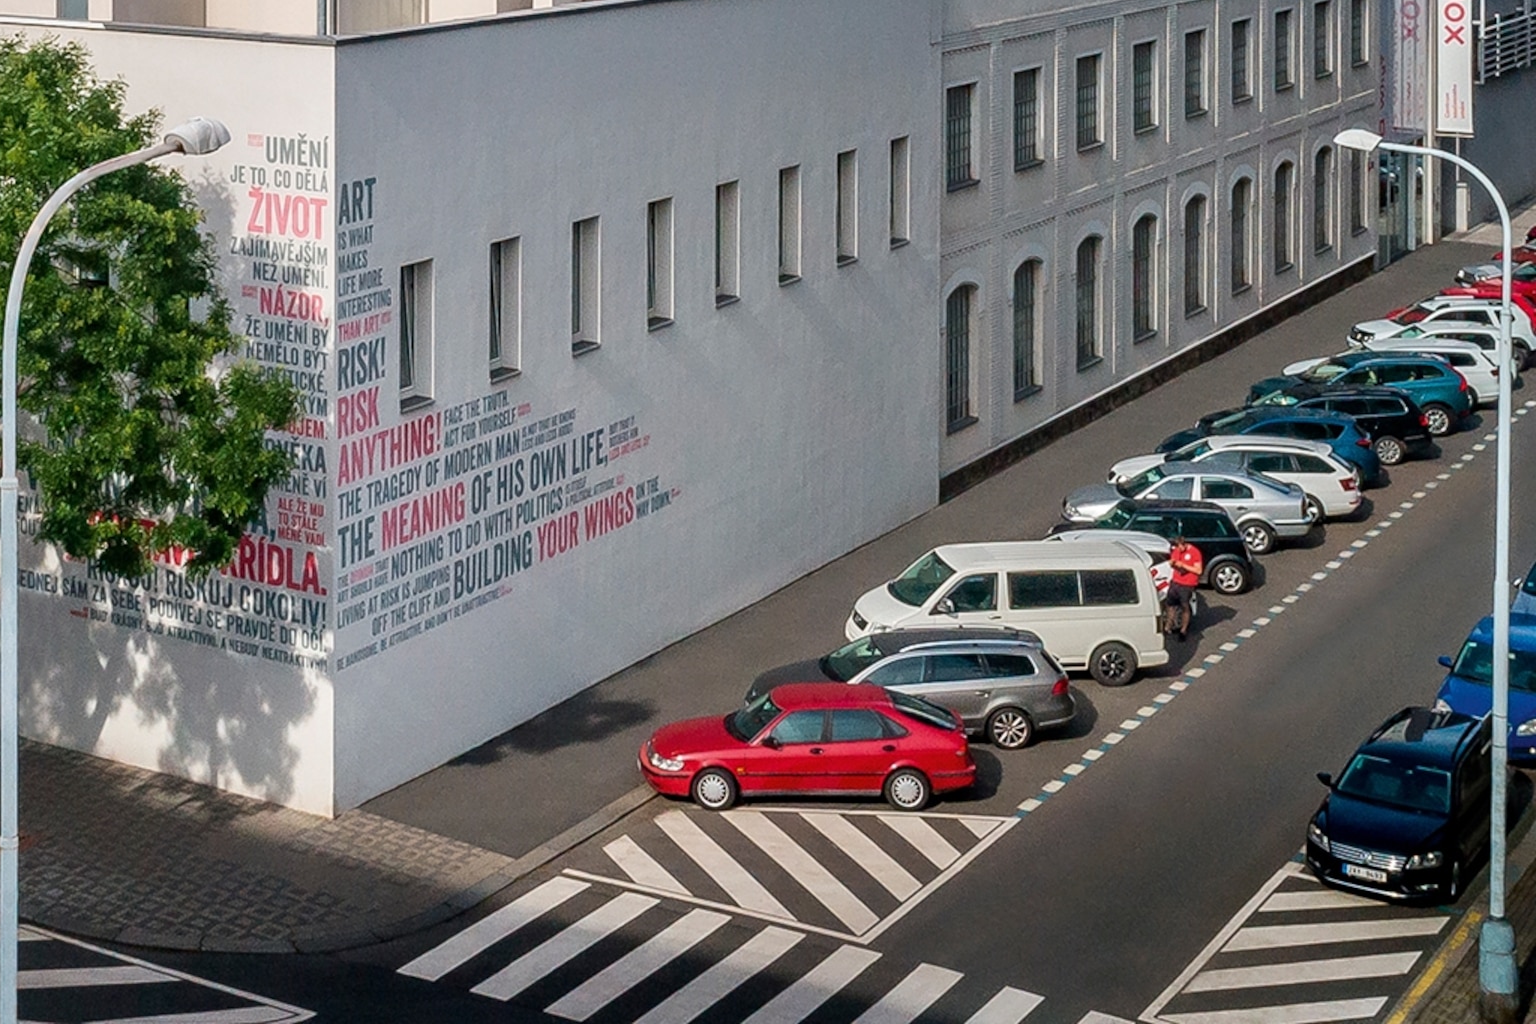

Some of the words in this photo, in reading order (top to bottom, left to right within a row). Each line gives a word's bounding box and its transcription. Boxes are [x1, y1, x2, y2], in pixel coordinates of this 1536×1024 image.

[266, 132, 328, 169] UMĚNÍ
[230, 165, 246, 184] JE
[250, 166, 269, 188] TO,
[274, 169, 291, 188] CO
[295, 168, 328, 193] DĚLÁ
[247, 185, 328, 240] ŽIVOT
[338, 177, 377, 226] ART
[230, 235, 328, 266] ZAJÍMAVĚJŠÍM
[338, 231, 347, 250] IS
[348, 224, 374, 248] WHAT
[253, 258, 278, 282] NEŽ
[282, 264, 328, 289] UMĚNÍ.
[338, 249, 368, 274] MAKES
[338, 275, 356, 297] LIFE
[358, 268, 383, 292] MORE
[260, 283, 329, 327] NÁZOR,
[338, 288, 392, 320] INTERESTING
[245, 314, 261, 337] ŽE
[265, 319, 308, 345] UMĚNÍ
[312, 328, 329, 347] BY
[338, 319, 361, 344] THAN
[246, 341, 299, 366] NEMĚLO
[305, 346, 328, 370] BÝT
[337, 336, 386, 391] RISK!
[337, 386, 380, 439] RISK
[444, 403, 464, 427] FACE
[465, 397, 480, 419] THE
[337, 412, 441, 487] ANYTHING!
[444, 426, 459, 449] ACT
[461, 421, 476, 443] FOR
[314, 476, 327, 499] VÍ
[337, 487, 363, 521] THE
[366, 465, 422, 510] TRAGEDY
[425, 458, 440, 488] OF
[444, 442, 492, 481] MODERN
[495, 429, 520, 462] MAN
[278, 497, 293, 511] ALE
[297, 497, 307, 513] ŽE
[310, 503, 324, 517] MU
[337, 516, 375, 569] THE
[382, 481, 465, 552] MEANING
[472, 470, 493, 515] OF
[497, 458, 524, 505] HIS
[530, 441, 566, 492] OWN
[572, 428, 608, 476] LIFE,
[279, 511, 289, 525] TO
[292, 513, 318, 531] STÁLE
[391, 535, 444, 581] NOTHING
[447, 527, 462, 557] TO
[466, 520, 481, 550] DO
[485, 509, 513, 542] WITH
[516, 486, 563, 529] POLITICS
[453, 530, 533, 600] BUILDING
[537, 510, 579, 563] YOUR
[584, 486, 634, 542] WINGS
[18, 568, 59, 594] EDNEJ
[63, 576, 88, 600] SÁM
[93, 584, 107, 604] ZA
[150, 596, 202, 626] PODÍVEJ
[206, 609, 222, 630] SE
[227, 614, 276, 643] PRAVDĚ
[280, 627, 297, 647] DO
[166, 570, 233, 608] RISKUJ
[239, 585, 327, 629] COKOLIV!
[337, 600, 365, 630] LIVING
[367, 594, 379, 616] AT
[381, 584, 400, 610] RISK
[402, 580, 411, 601] IS
[412, 564, 450, 596] JUMPING
[372, 612, 388, 636] OFF
[390, 604, 407, 628] THE
[409, 593, 432, 620] CLIFF
[433, 586, 450, 610] AND
